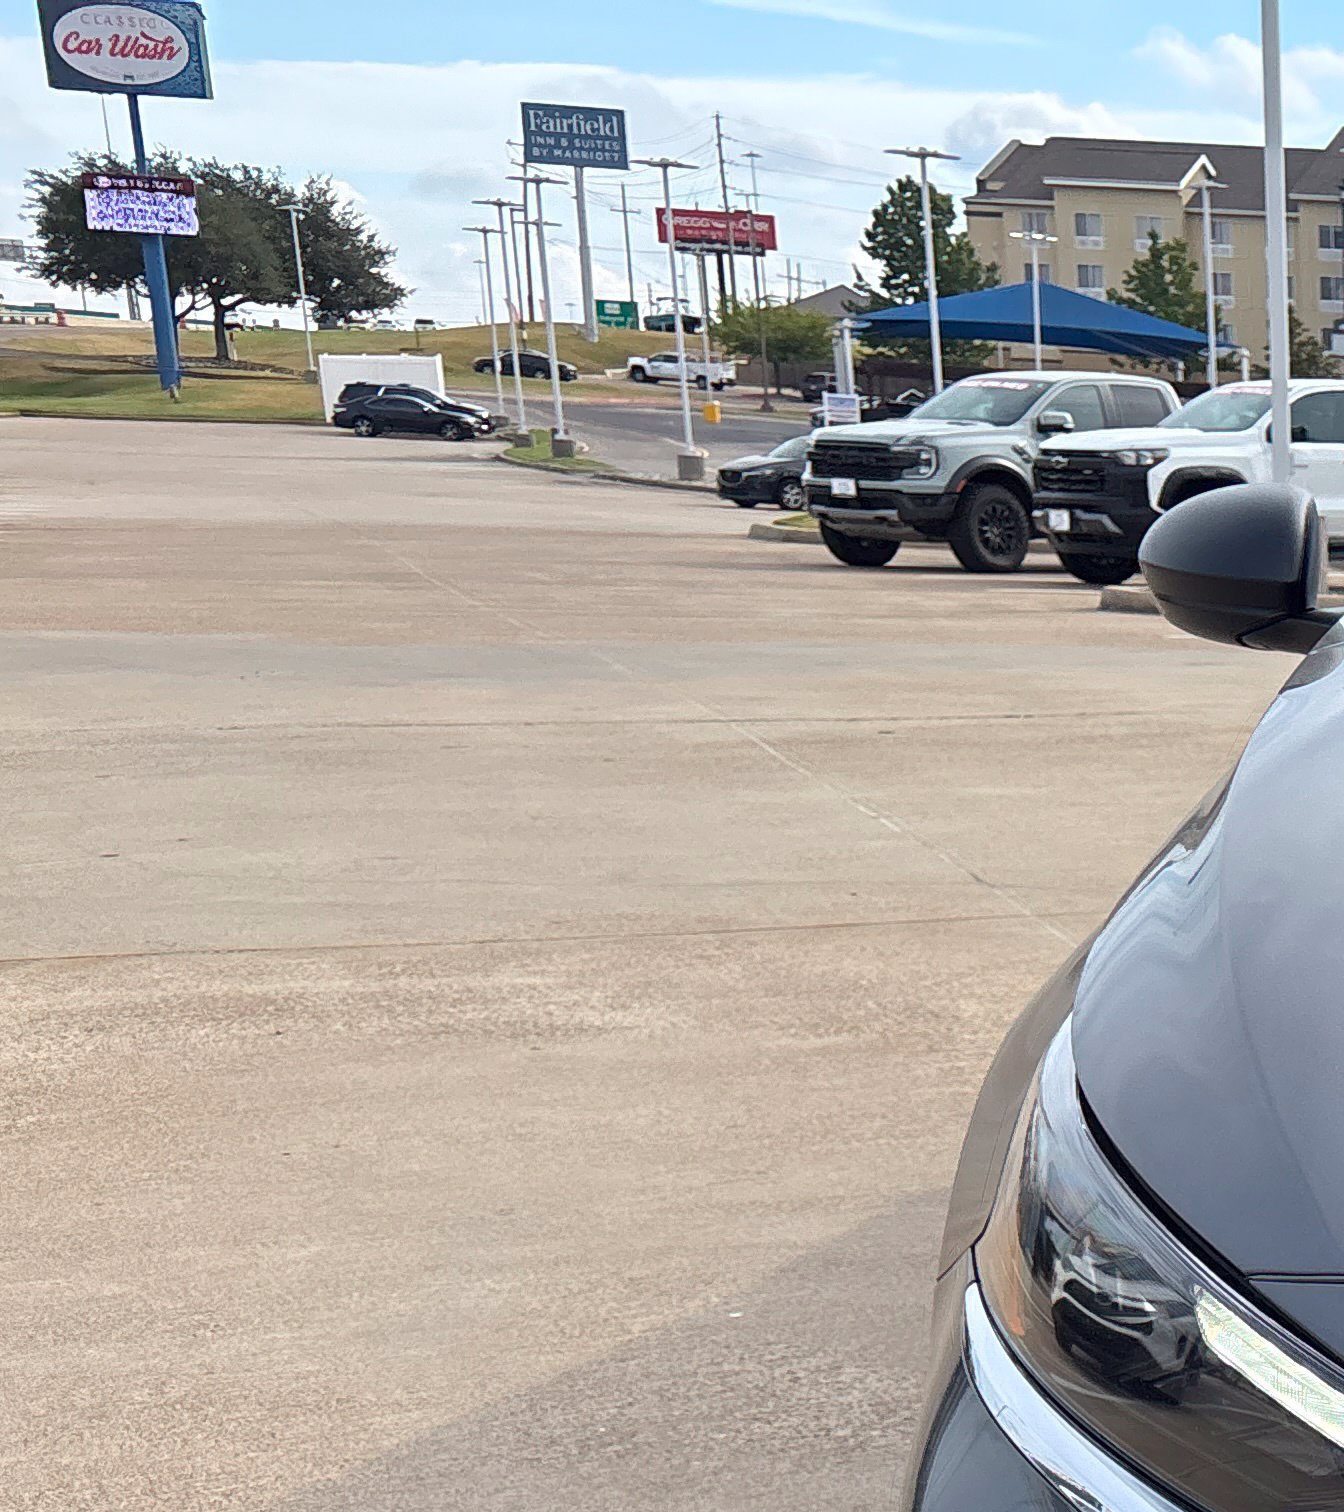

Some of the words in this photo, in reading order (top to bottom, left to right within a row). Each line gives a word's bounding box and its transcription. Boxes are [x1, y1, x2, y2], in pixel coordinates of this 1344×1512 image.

[62, 31, 102, 56] Car
[109, 30, 182, 60] Wash
[528, 109, 619, 137] Fairfield
[531, 135, 555, 146] INN
[574, 138, 620, 151] SUITES
[532, 147, 549, 157] BY
[553, 149, 620, 161] MARRIOTT
